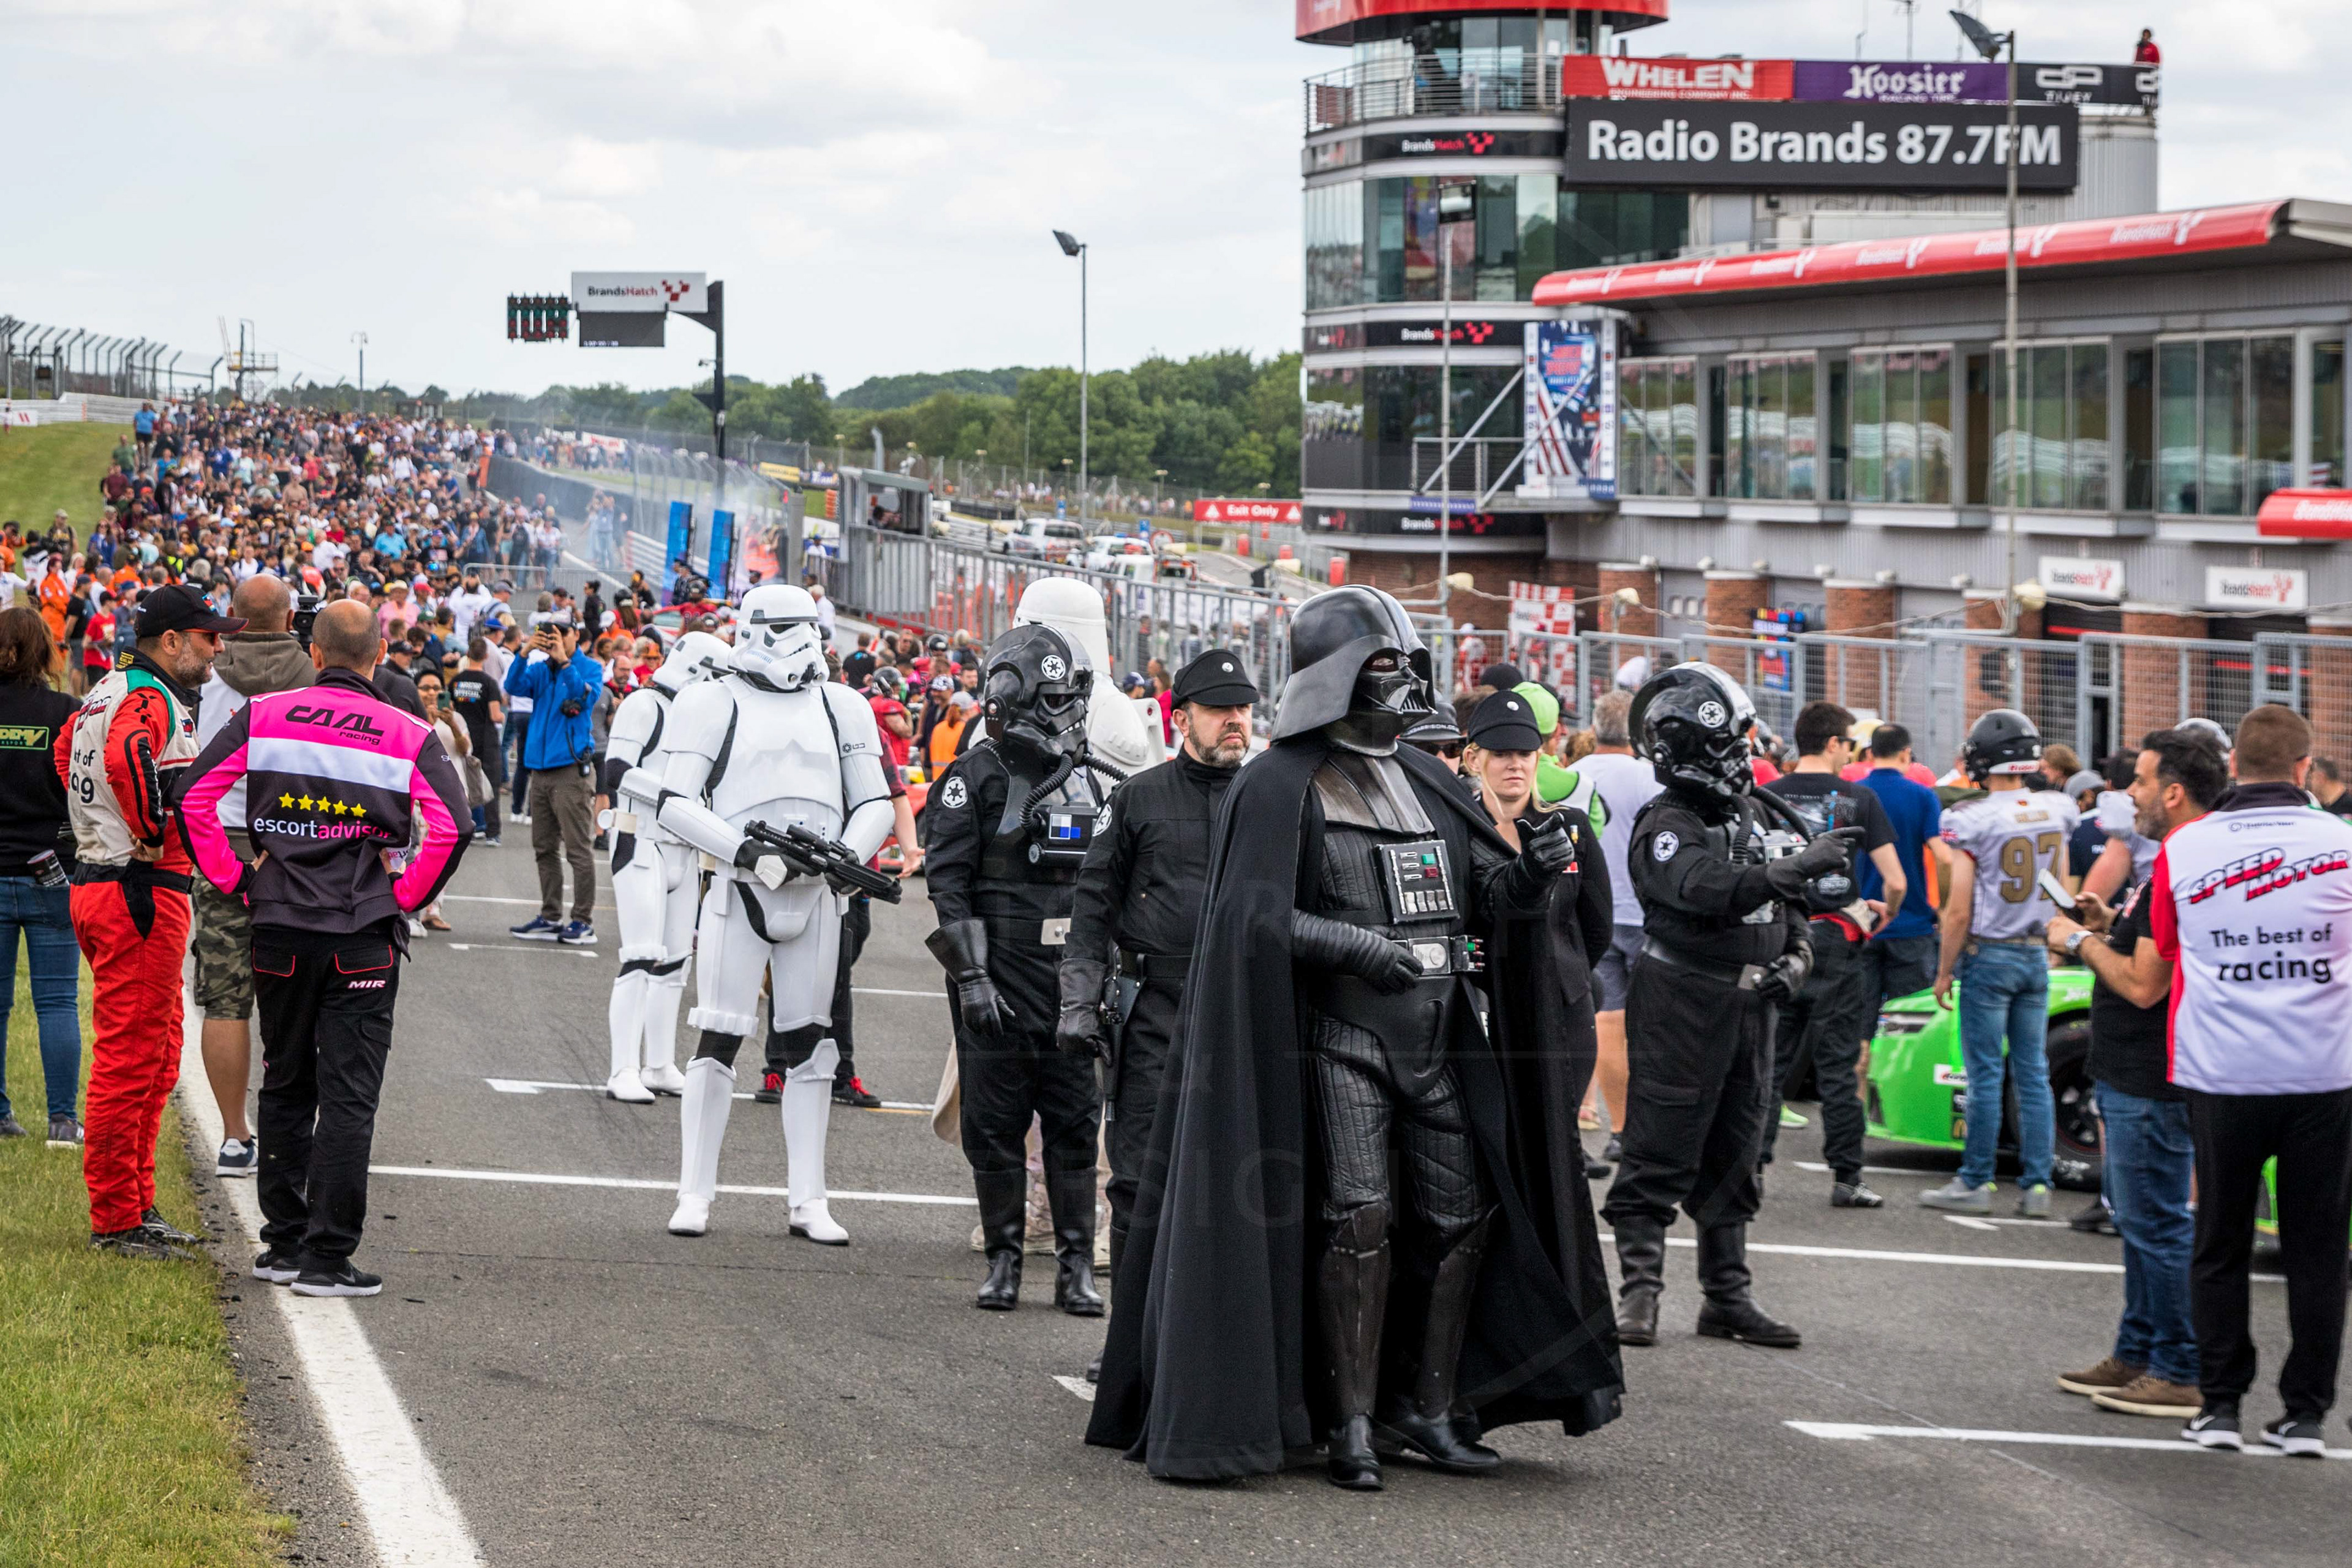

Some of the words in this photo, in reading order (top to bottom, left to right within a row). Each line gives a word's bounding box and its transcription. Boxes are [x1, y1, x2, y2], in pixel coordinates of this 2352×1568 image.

[1600, 58, 1754, 88] WHELEN
[1842, 64, 1967, 99] Hoosier
[1401, 138, 1464, 153] BrandsHatch
[1588, 119, 1720, 162] Radio
[1729, 120, 1888, 164] Brands
[1896, 123, 2062, 165] 87.7FM
[587, 285, 658, 297] BrandsHatch
[1226, 504, 1250, 516] Exit
[1251, 504, 1280, 519] Only
[285, 705, 384, 737] CAAL
[339, 731, 381, 746] racing
[83, 750, 96, 766] of
[2000, 831, 2062, 902] 97
[2188, 847, 2286, 904] SPEED
[2245, 850, 2351, 902] MOTOR
[2210, 929, 2248, 948] The
[2256, 926, 2303, 944] best
[2310, 922, 2332, 941] of
[2218, 951, 2332, 984] racing
[348, 980, 386, 989] MIR
